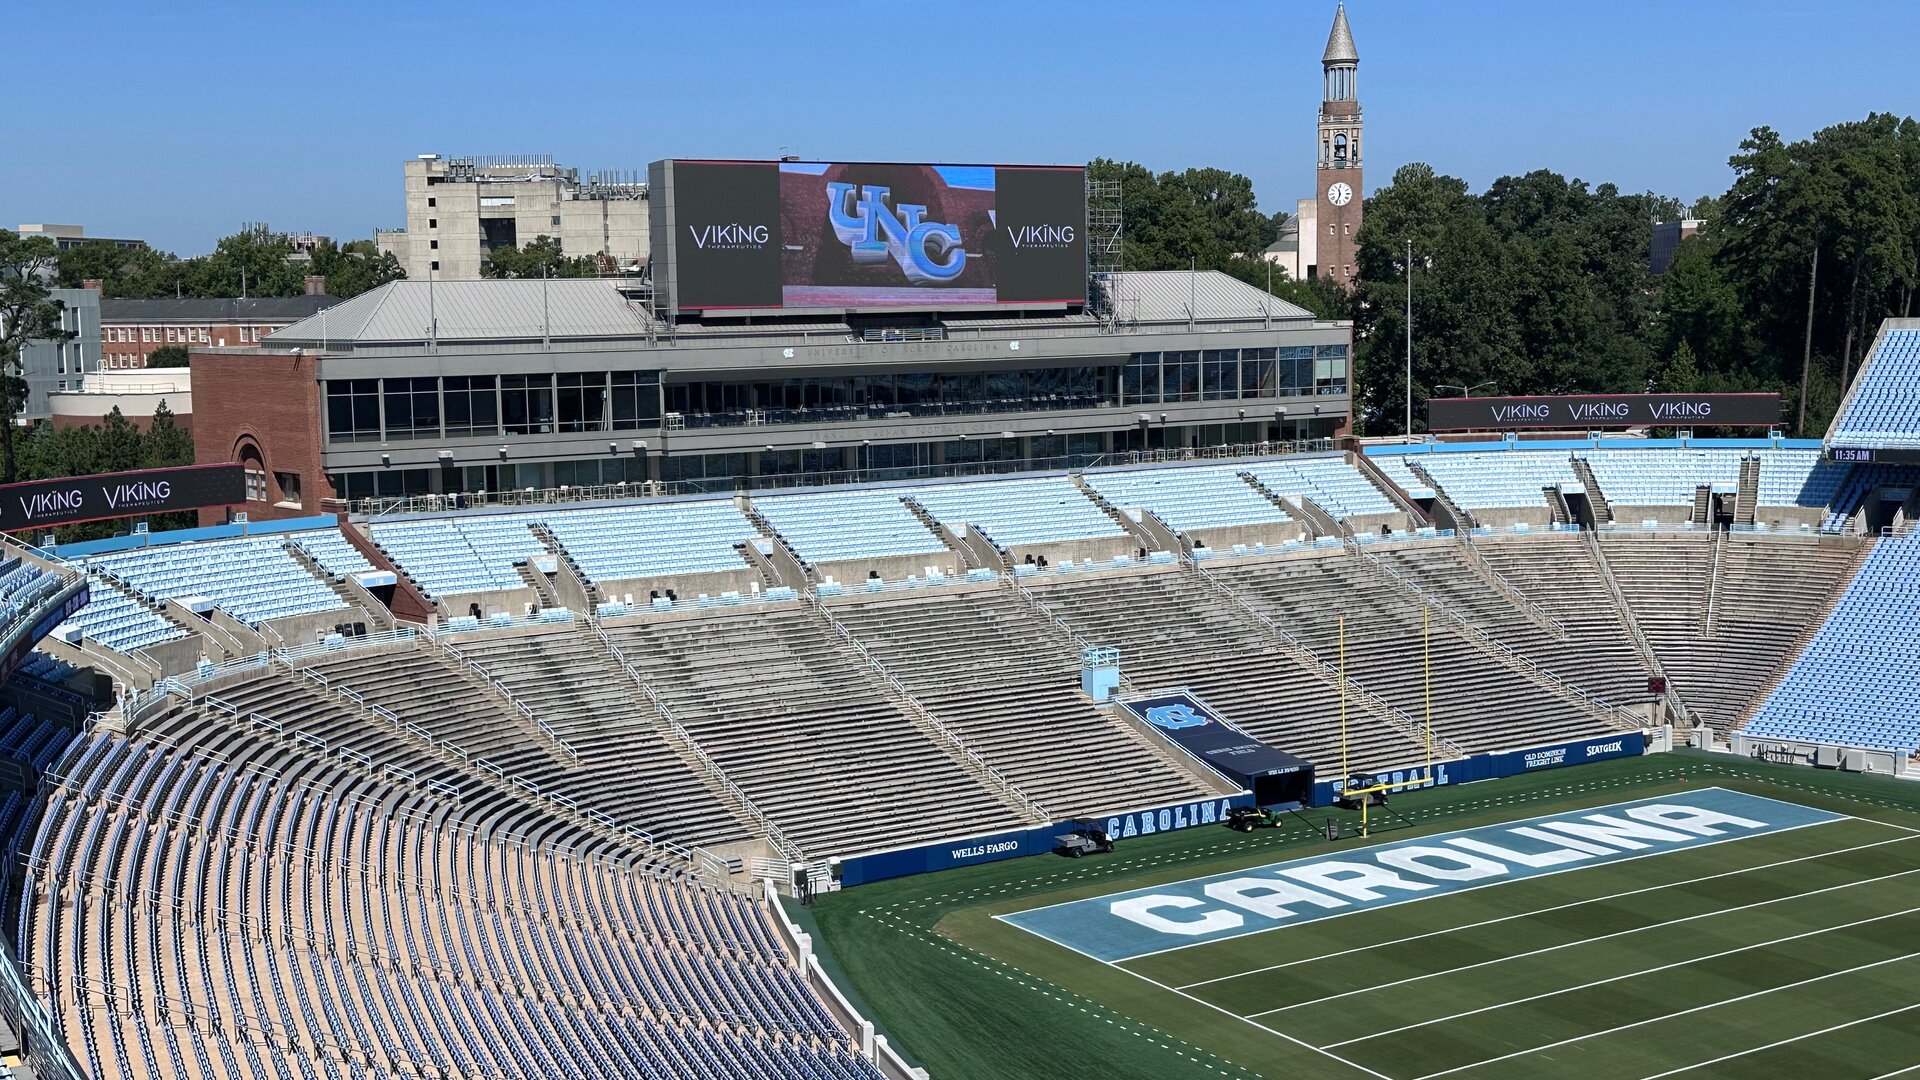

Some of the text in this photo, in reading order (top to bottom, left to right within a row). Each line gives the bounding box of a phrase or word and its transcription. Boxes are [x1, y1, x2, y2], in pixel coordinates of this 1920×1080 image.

[826, 182, 966, 281] UNC
[1835, 450, 1870, 461] 11:35 AM
[1524, 753, 1537, 761] OLD
[1586, 740, 1623, 757] SEATGEEK
[1551, 755, 1565, 764] LINE
[1107, 798, 1232, 840] CAROLINA
[952, 840, 1019, 859] WELLS FARGO
[1110, 803, 1770, 936] CAROLINA
